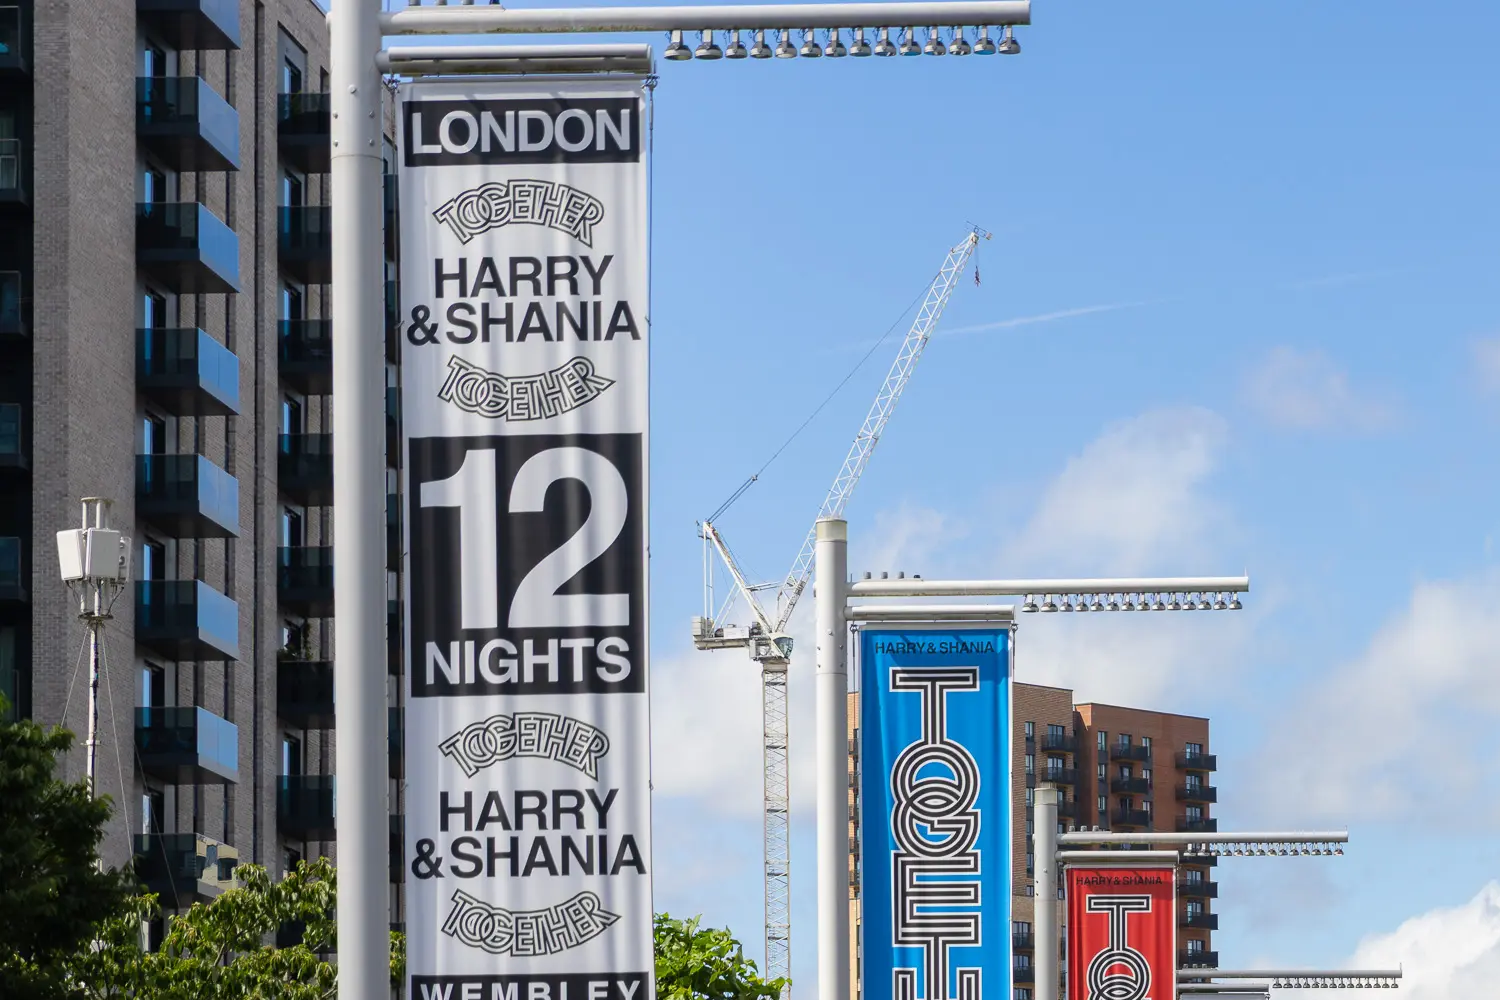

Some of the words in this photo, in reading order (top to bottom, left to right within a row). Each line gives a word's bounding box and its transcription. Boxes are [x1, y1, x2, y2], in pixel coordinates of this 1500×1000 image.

[412, 109, 630, 154] LONDON
[433, 179, 604, 248] TOGETHER
[434, 254, 614, 298] HARRY
[438, 354, 616, 422] TOGETHER
[420, 446, 630, 629] 12
[425, 636, 631, 685] NIGHTS
[875, 642, 926, 654] HARRY
[939, 641, 994, 654] SHANIA
[438, 711, 610, 781] TOGETHER
[439, 788, 619, 832] HARRY
[1076, 876, 1113, 885] HARRY
[1122, 876, 1162, 885] SHANIA
[441, 888, 621, 957] TOGETHER
